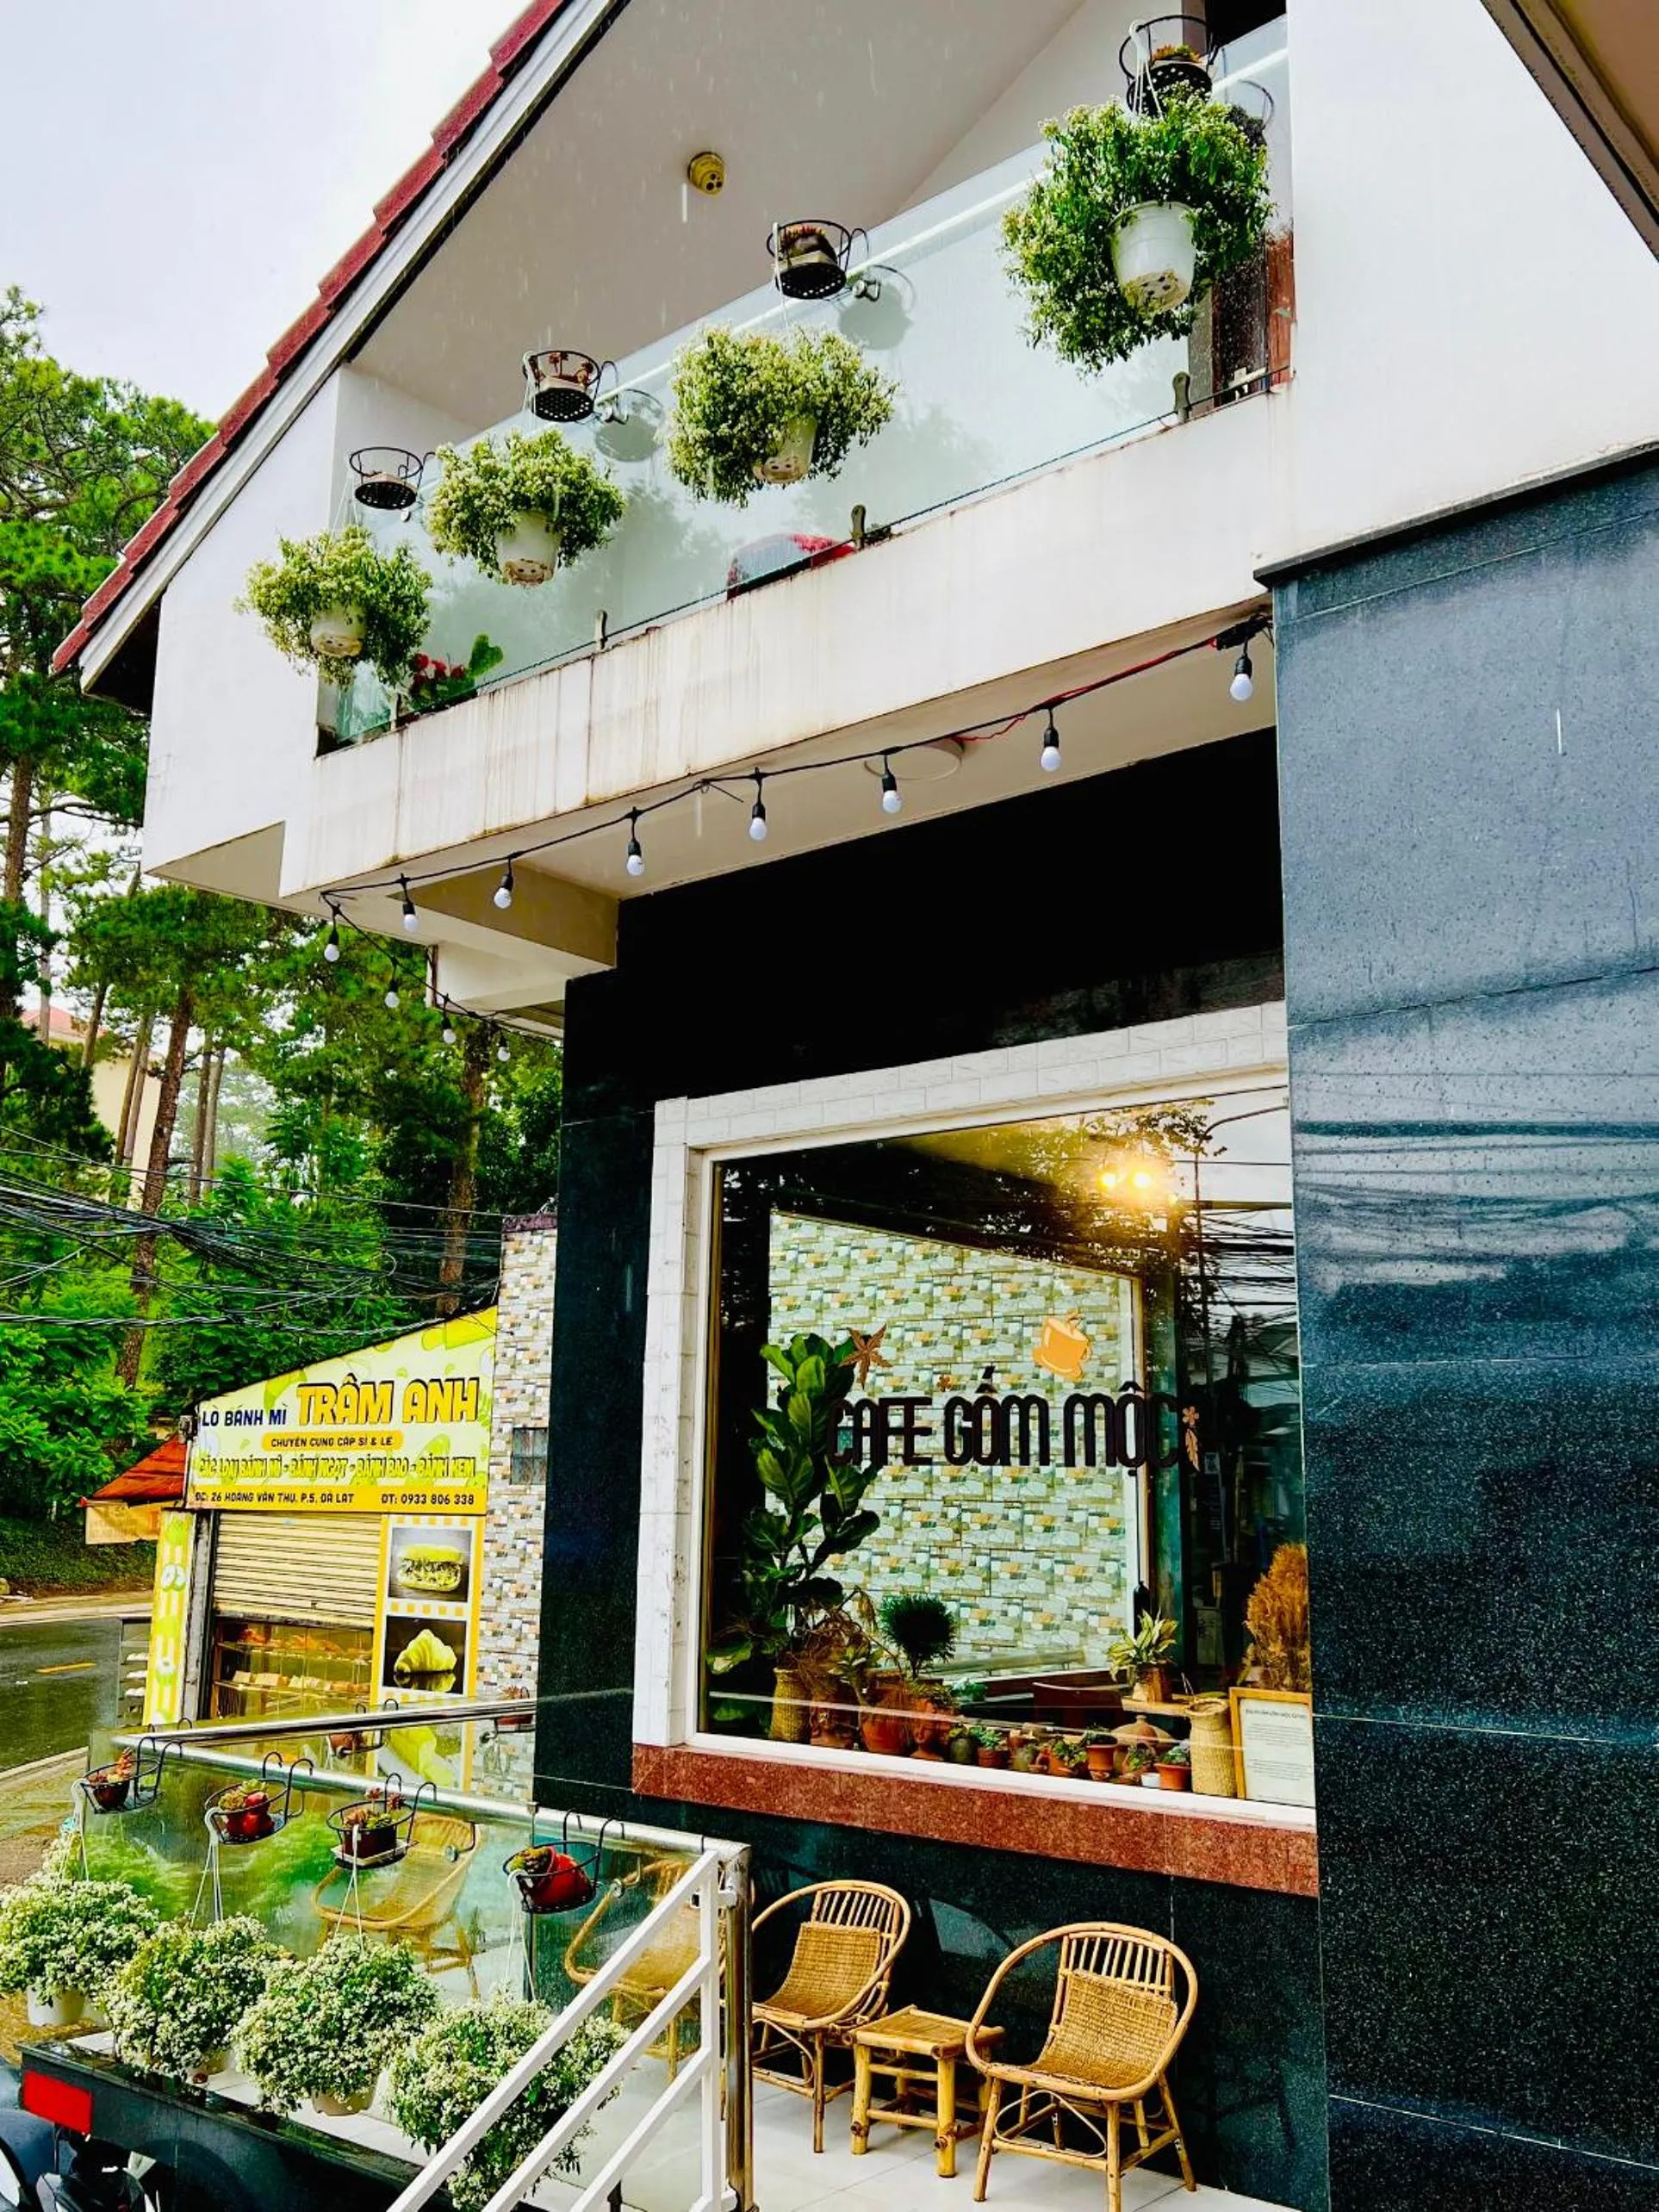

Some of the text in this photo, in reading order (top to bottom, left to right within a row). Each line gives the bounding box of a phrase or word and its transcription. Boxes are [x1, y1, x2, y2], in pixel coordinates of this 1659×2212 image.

[202, 1372, 480, 1426] LÒ BÁNH MÌ TRÂM ANH
[828, 1396, 933, 1466] CAFE
[309, 1437, 334, 1447] CUNG
[241, 1454, 268, 1478] BÁNH
[289, 1453, 320, 1478] BÁNH
[357, 1453, 387, 1478] BÁNH
[417, 1453, 450, 1478] BÁNH
[451, 1457, 476, 1478] KEM
[211, 1491, 221, 1502] 26
[401, 1494, 426, 1505] 0933
[431, 1494, 450, 1505] 806
[454, 1494, 475, 1505] 338
